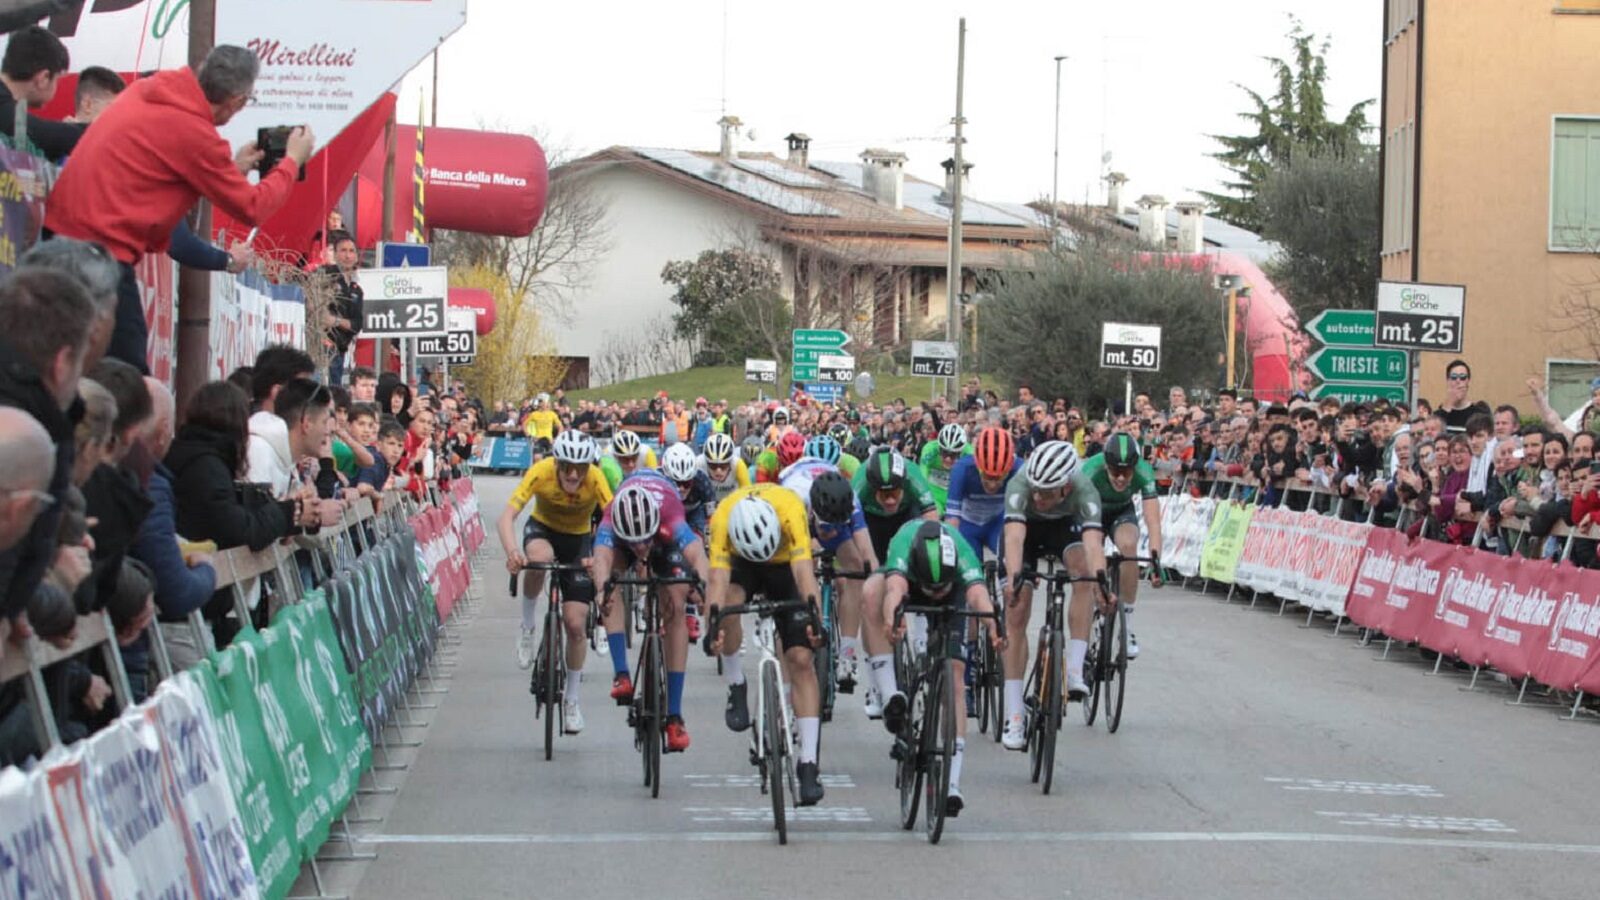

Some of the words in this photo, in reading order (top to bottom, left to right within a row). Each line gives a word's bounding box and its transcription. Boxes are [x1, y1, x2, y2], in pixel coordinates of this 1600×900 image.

[247, 38, 356, 67] Mirellini
[430, 167, 463, 181] Banca
[464, 170, 491, 184] della
[493, 173, 527, 187] Marca
[367, 309, 402, 329] mt.
[406, 303, 439, 329] 25
[1382, 322, 1416, 342] mt.
[1420, 319, 1454, 345] 25
[420, 338, 444, 352] mt.
[447, 333, 470, 352] 50
[1106, 350, 1129, 365] mt.
[1132, 348, 1155, 366] 50
[1331, 356, 1379, 375] TRIESTE
[1388, 361, 1401, 373] A4
[820, 371, 834, 381] mt.
[834, 370, 853, 381] 100
[915, 362, 934, 374] mt.
[936, 360, 953, 375] 75
